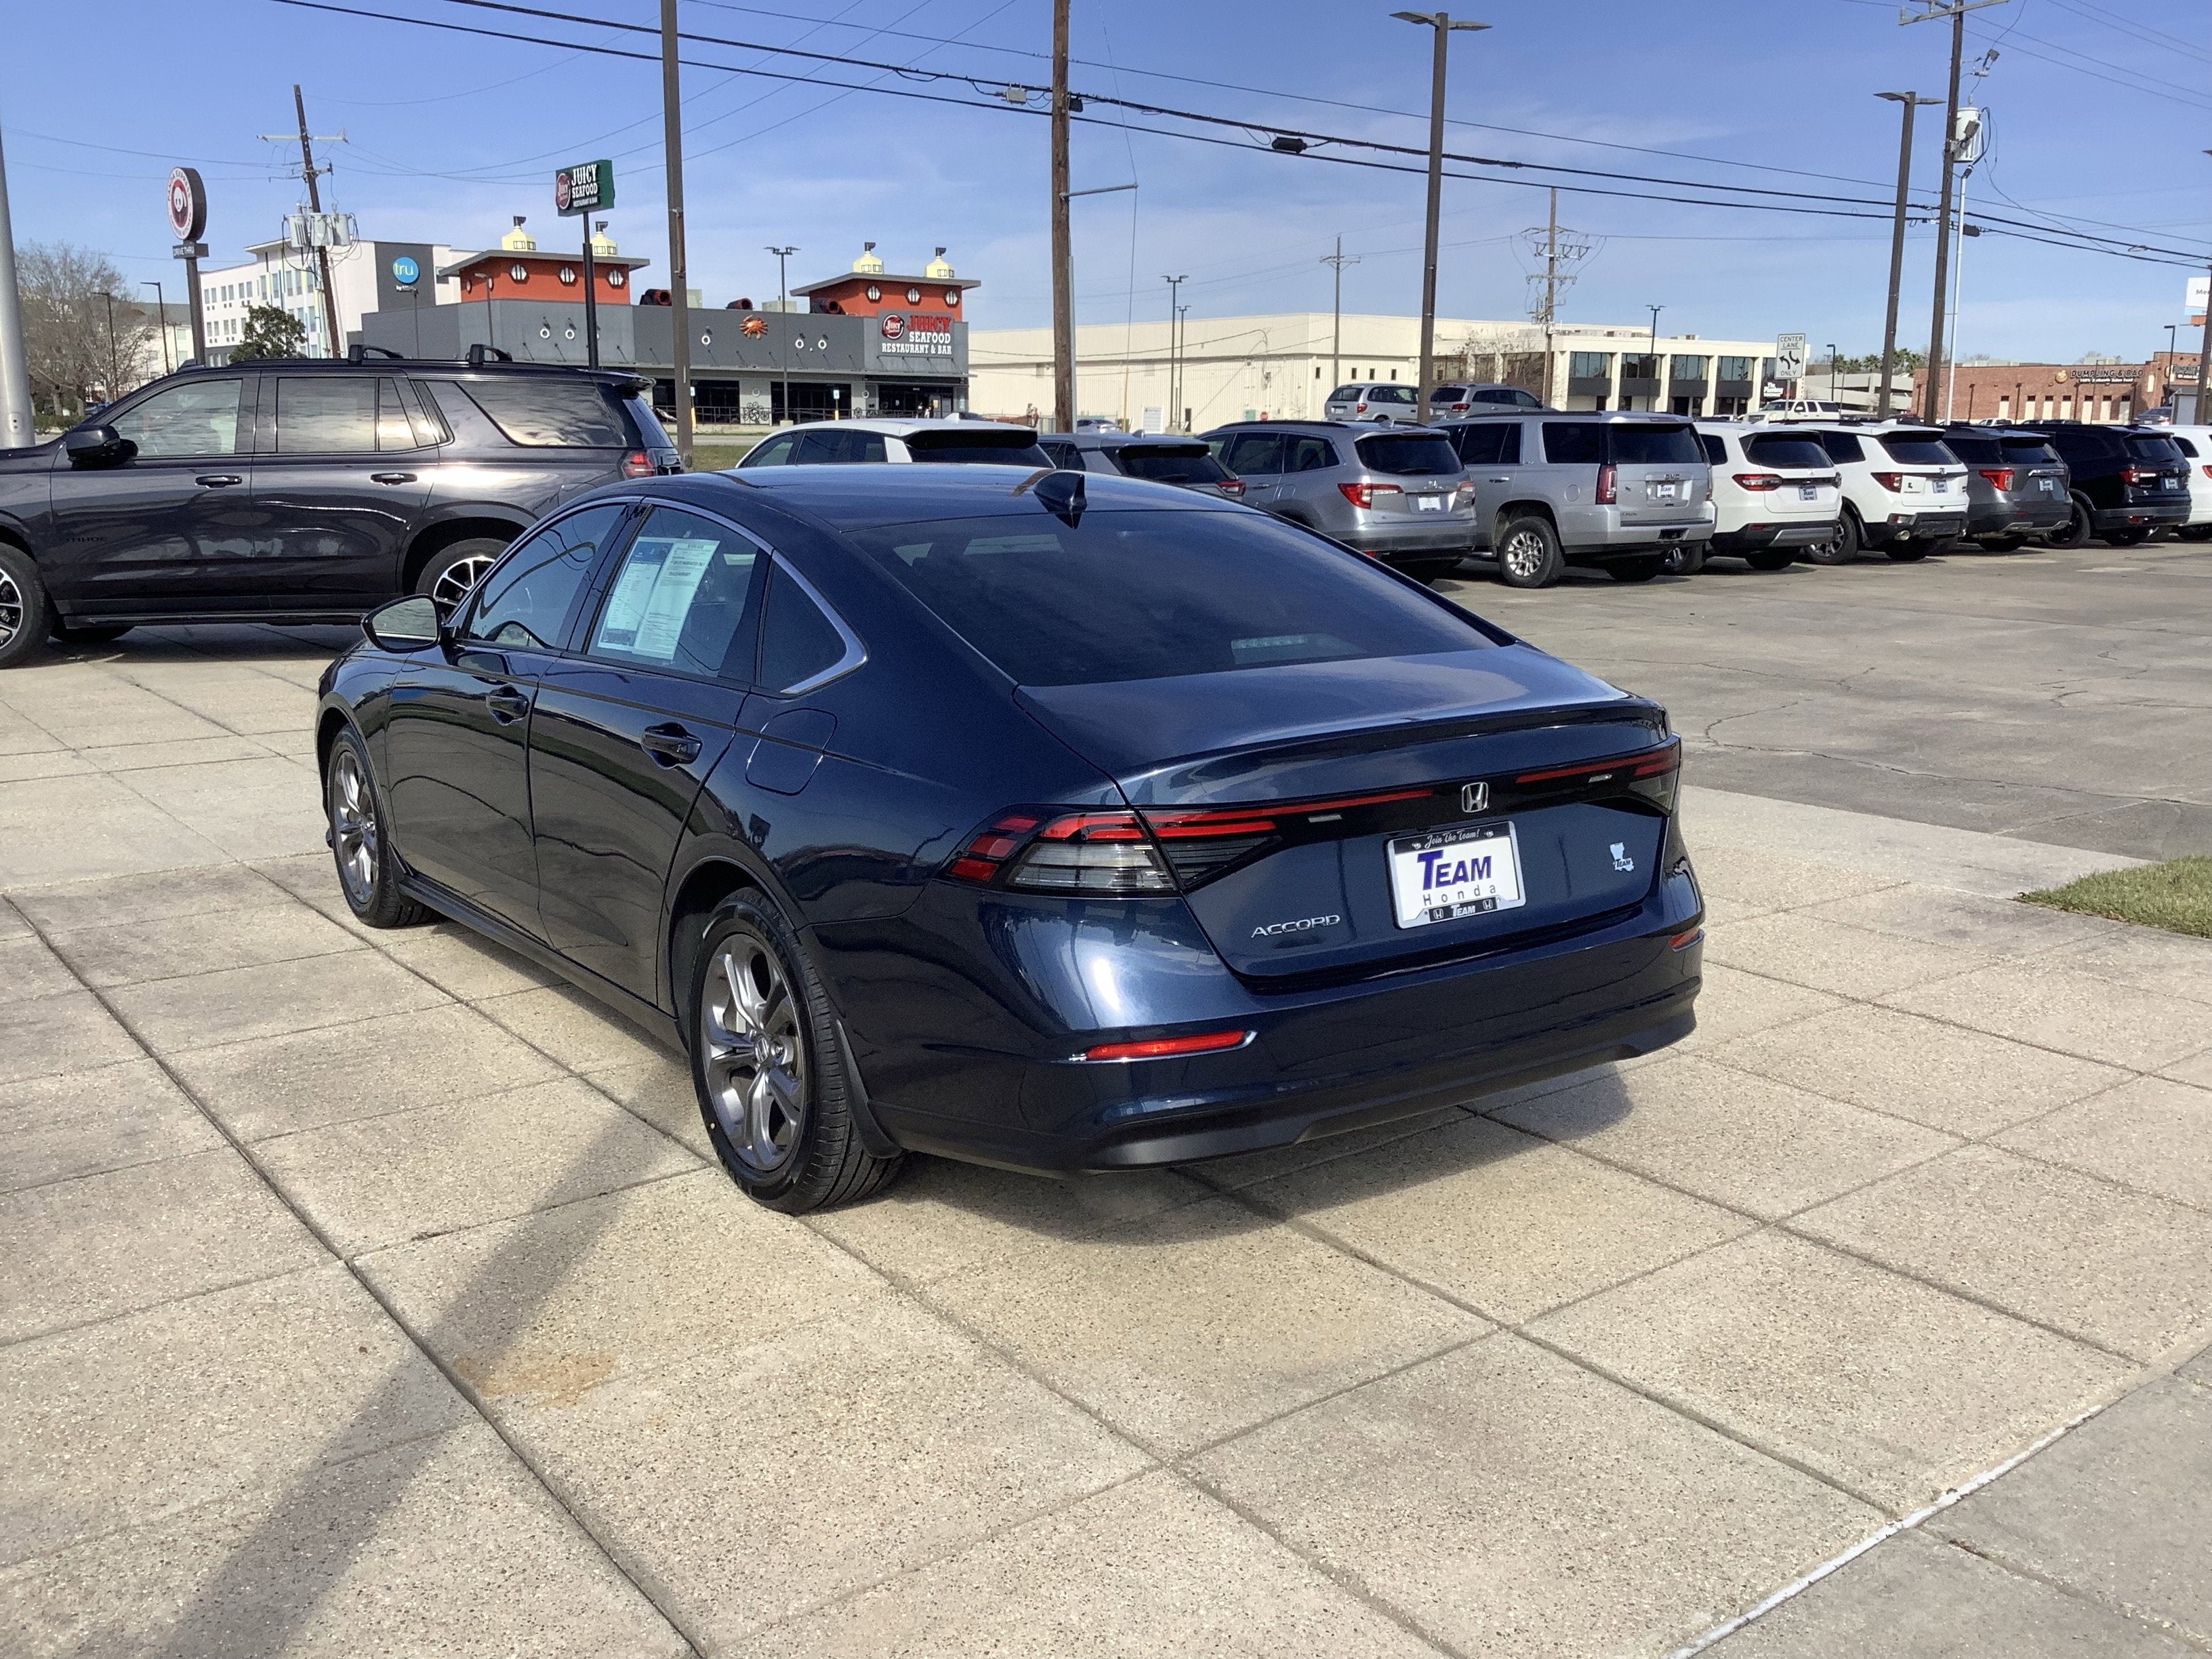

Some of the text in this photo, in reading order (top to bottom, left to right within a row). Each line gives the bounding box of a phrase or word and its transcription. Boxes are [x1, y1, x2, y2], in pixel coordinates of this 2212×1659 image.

[571, 164, 597, 186] JUICY
[572, 182, 598, 199] SEAFOOD
[394, 262, 414, 276] tru
[907, 315, 951, 332] JUICY
[909, 331, 951, 344] SEAFOOD
[882, 343, 952, 355] RESTAURANT & BAR
[2125, 369, 2144, 377] BAO
[1425, 829, 1480, 848] Join The Team!
[1423, 884, 1496, 907] Honda
[1251, 914, 1340, 939] ACCORD
